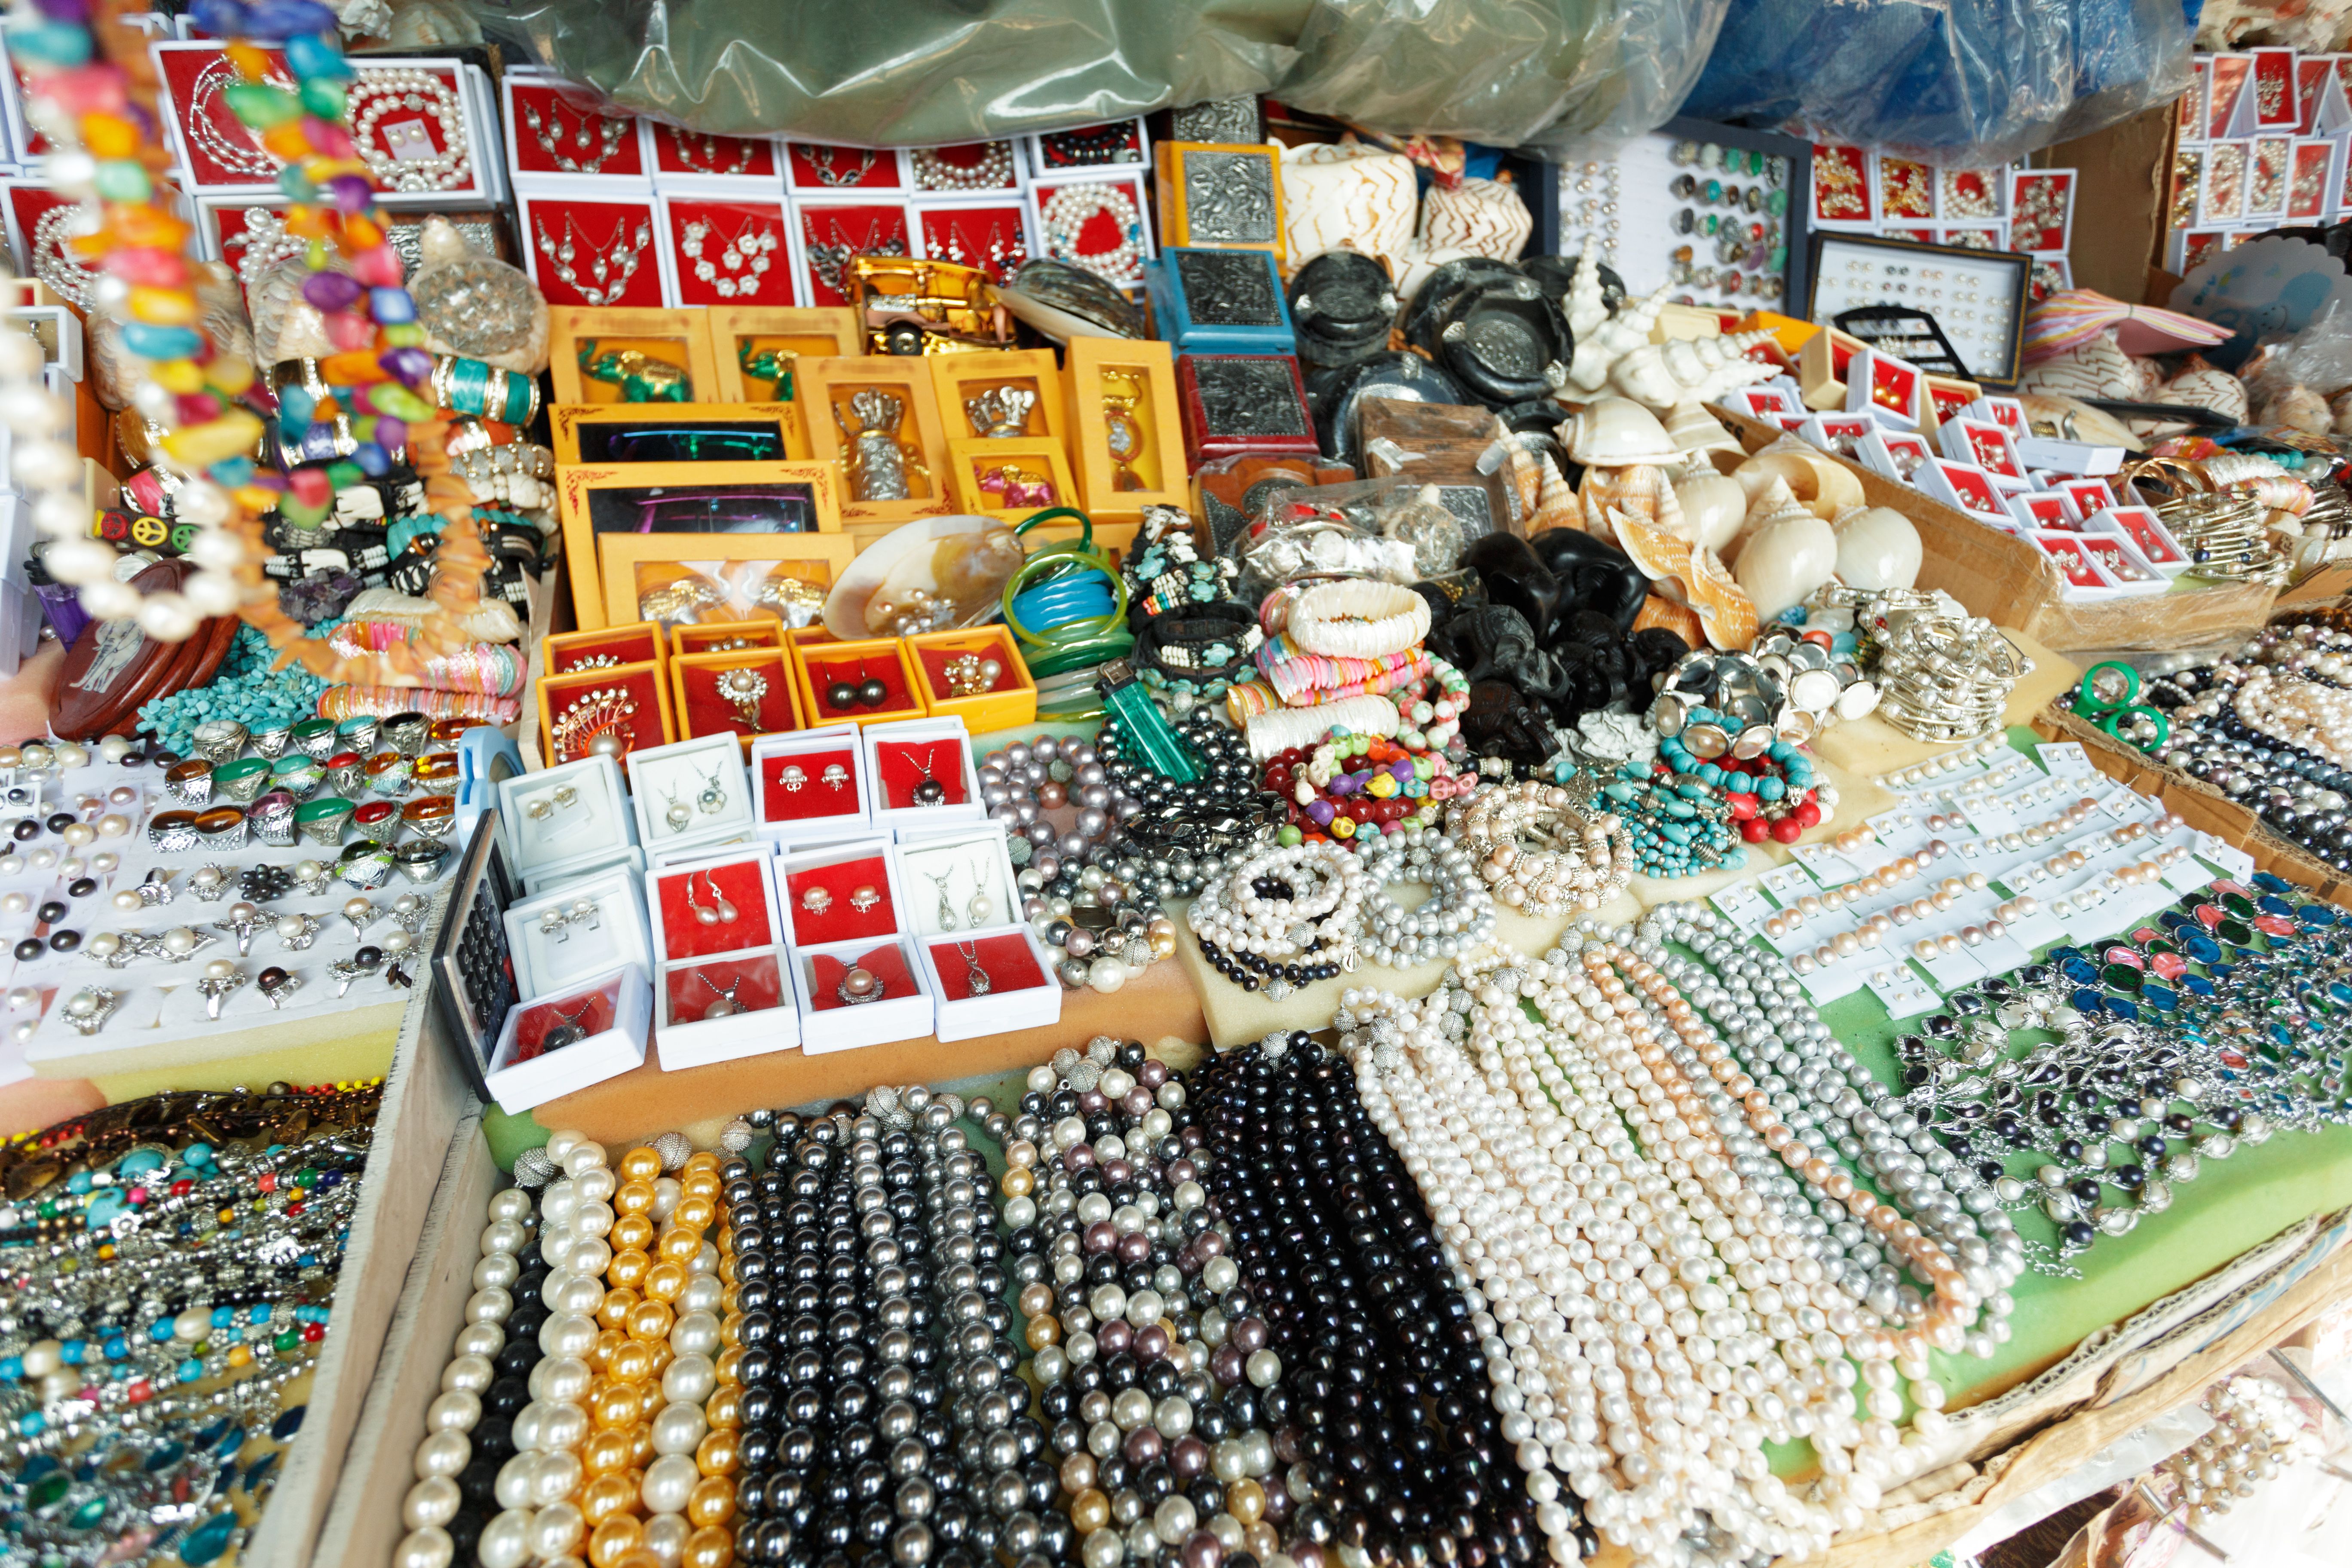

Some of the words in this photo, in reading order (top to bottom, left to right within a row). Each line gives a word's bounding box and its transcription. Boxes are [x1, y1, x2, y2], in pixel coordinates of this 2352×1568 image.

[1719, 418, 1744, 441] ES
[481, 902, 486, 911] 7
[490, 929, 494, 940] 8
[471, 937, 475, 946] 1
[485, 945, 489, 956] 5
[464, 954, 469, 965] 0
[498, 956, 502, 965] 9
[480, 962, 484, 974] 2
[494, 972, 498, 983] 6
[489, 989, 493, 1001] 3
